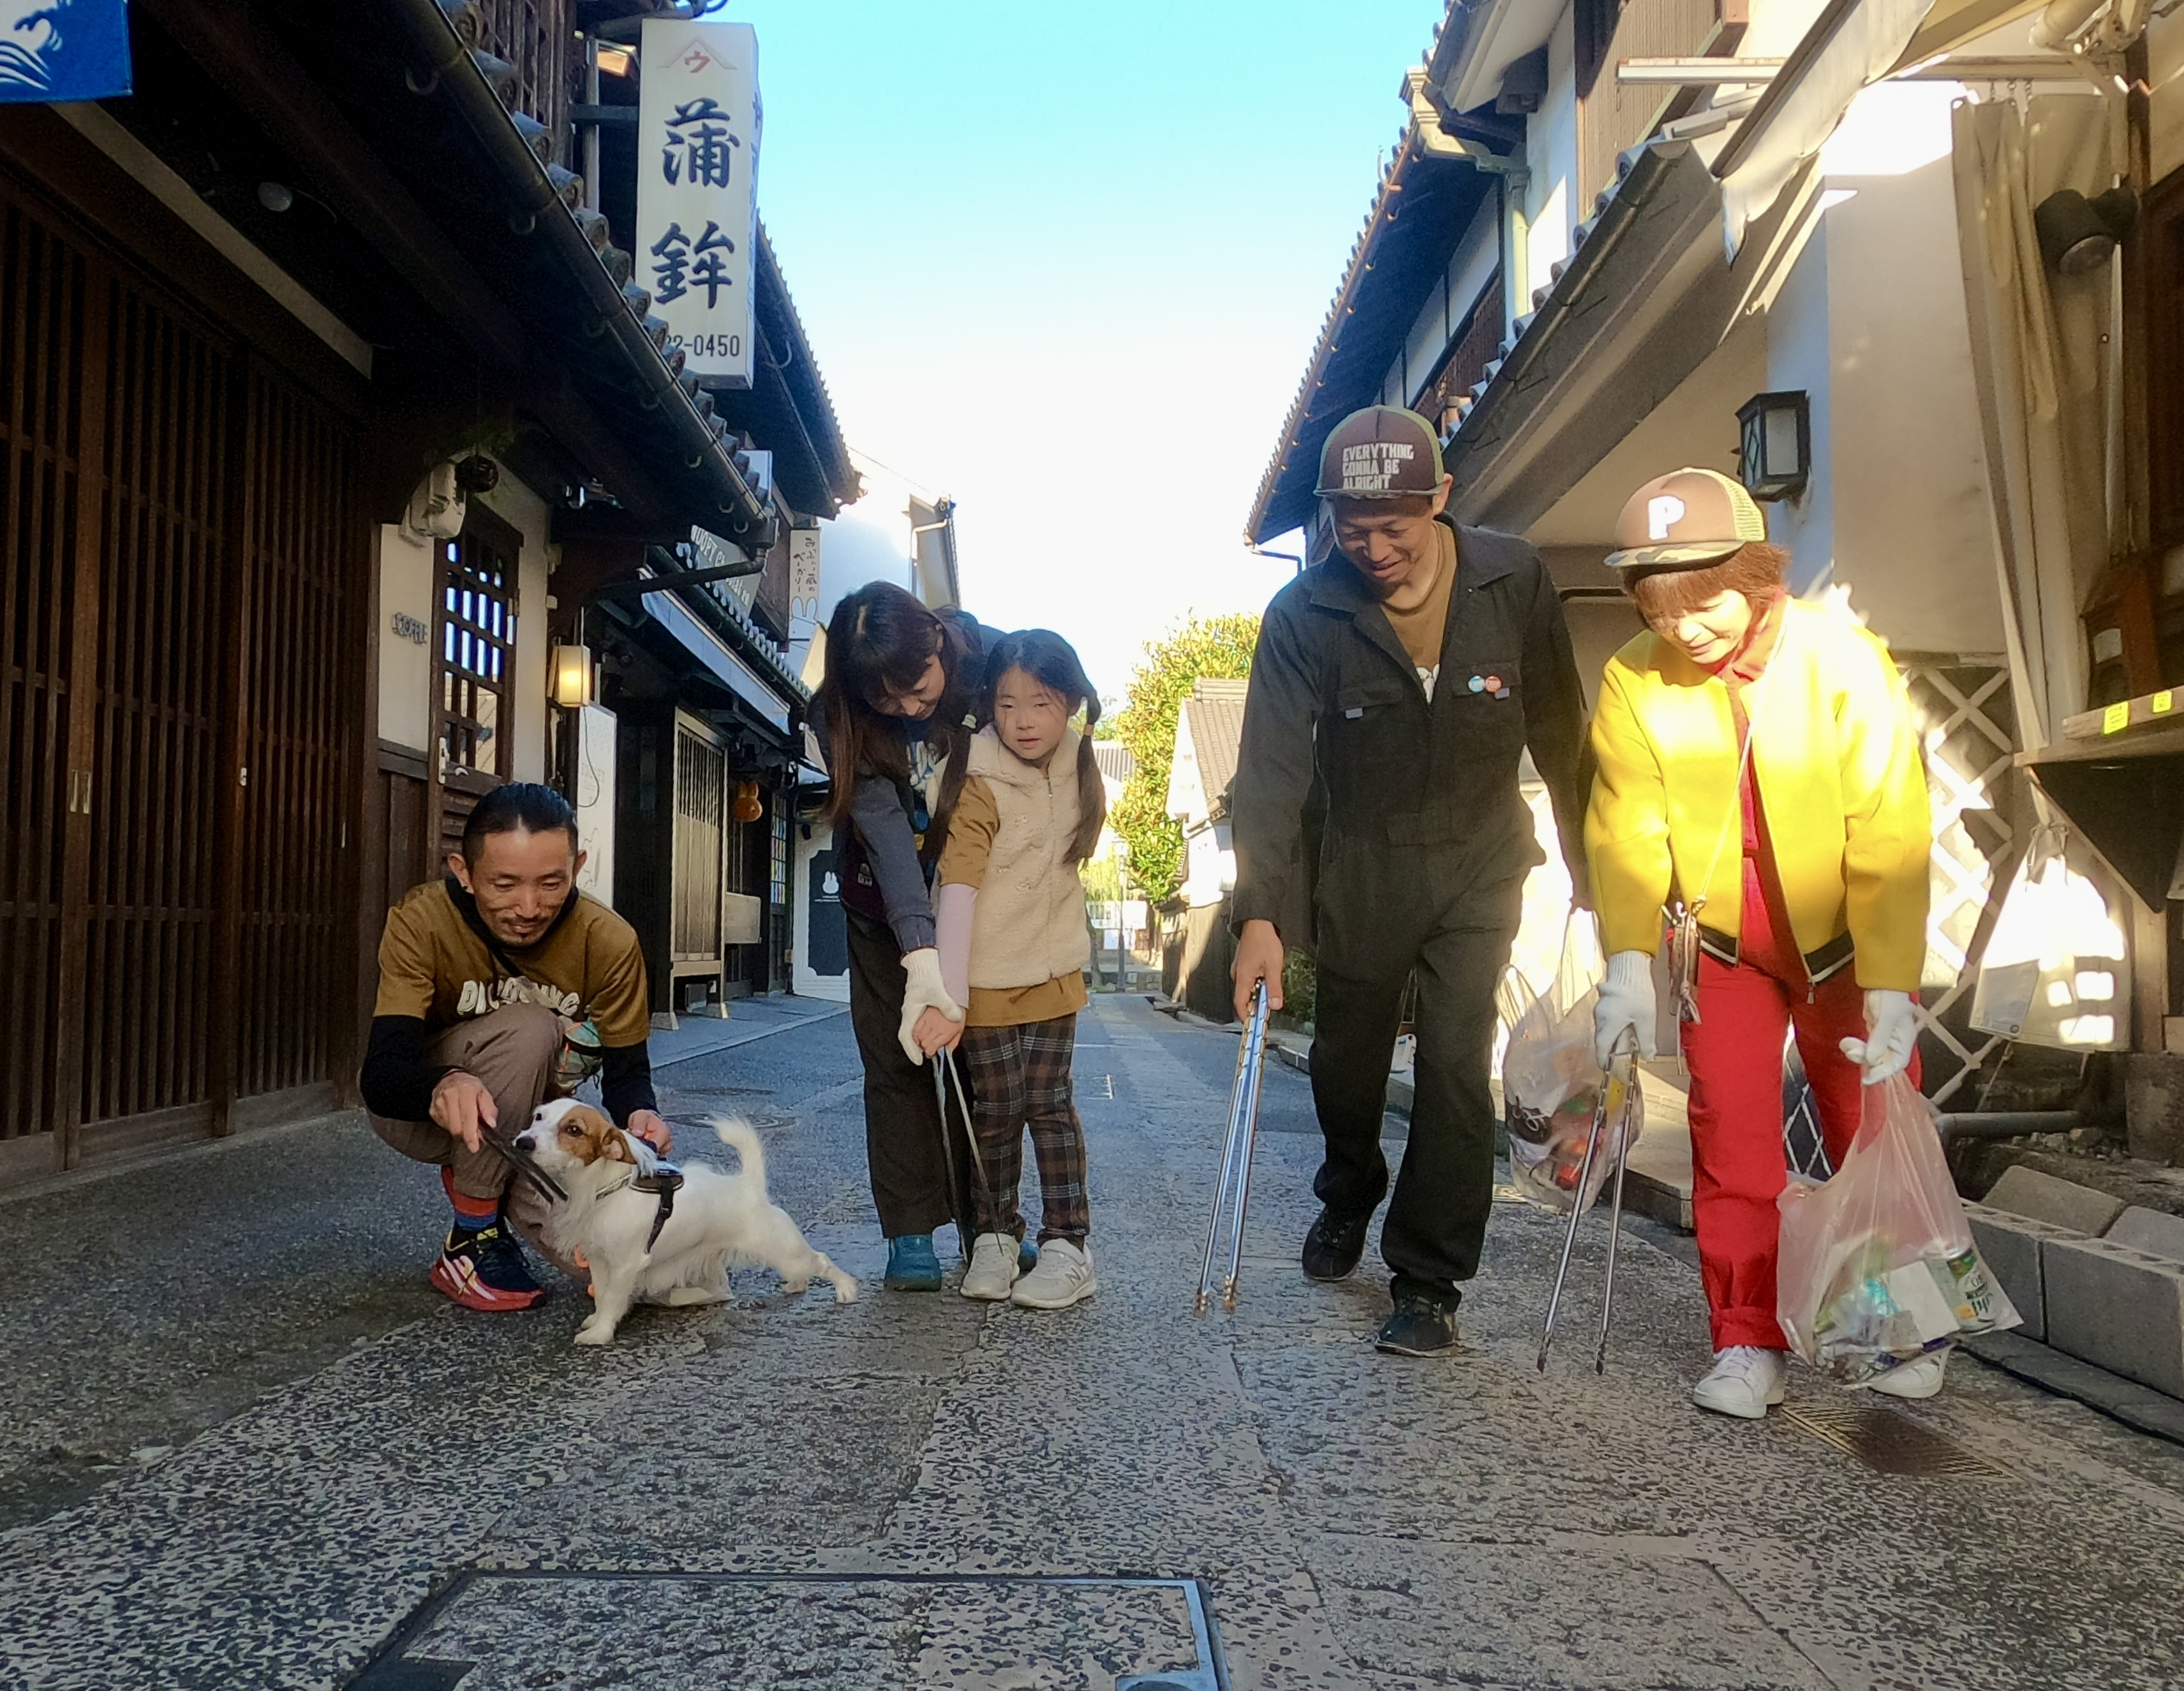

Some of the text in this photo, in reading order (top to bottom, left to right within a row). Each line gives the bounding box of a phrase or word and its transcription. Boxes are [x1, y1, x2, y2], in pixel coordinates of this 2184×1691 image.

[684, 50, 710, 73] ウ
[650, 97, 741, 309] 蒲鉾
[1342, 442, 1415, 462] EVERYTHING
[1342, 459, 1400, 477] GONNA BE
[1342, 474, 1392, 491] ALRIGHT
[1648, 494, 1686, 541] P
